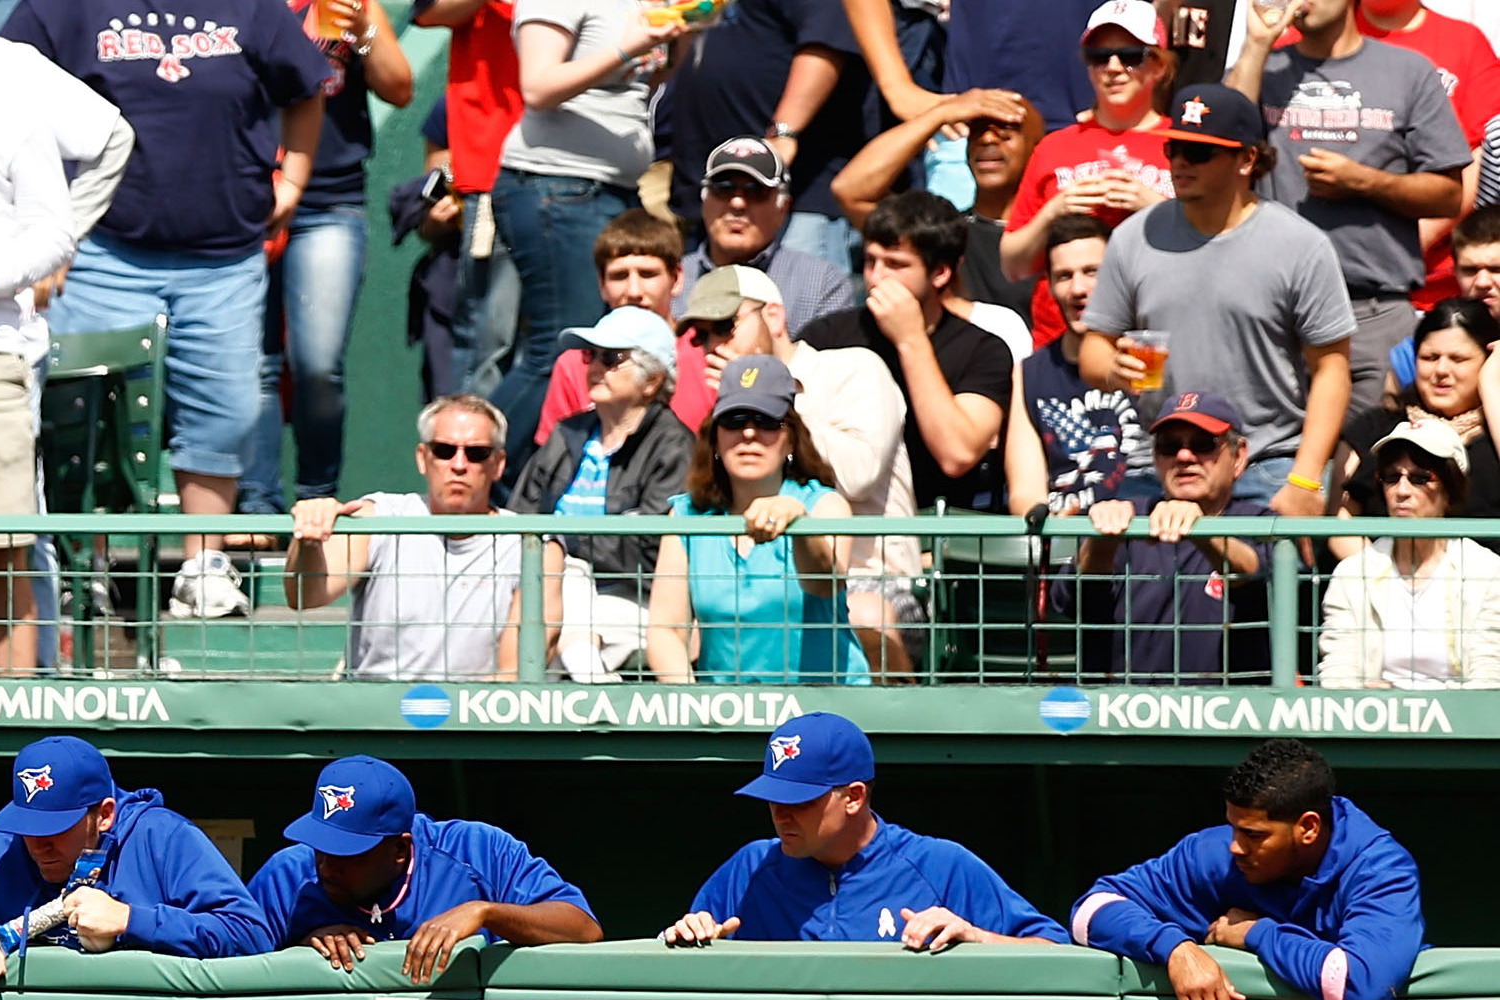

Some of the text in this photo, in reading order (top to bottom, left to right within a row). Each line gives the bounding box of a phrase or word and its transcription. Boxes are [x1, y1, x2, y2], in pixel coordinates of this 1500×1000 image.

[97, 26, 243, 62] RED SOX
[1173, 391, 1200, 411] B
[458, 689, 803, 726] KONICA MINOLTA
[1098, 693, 1453, 733] KONICA MINOLTA
